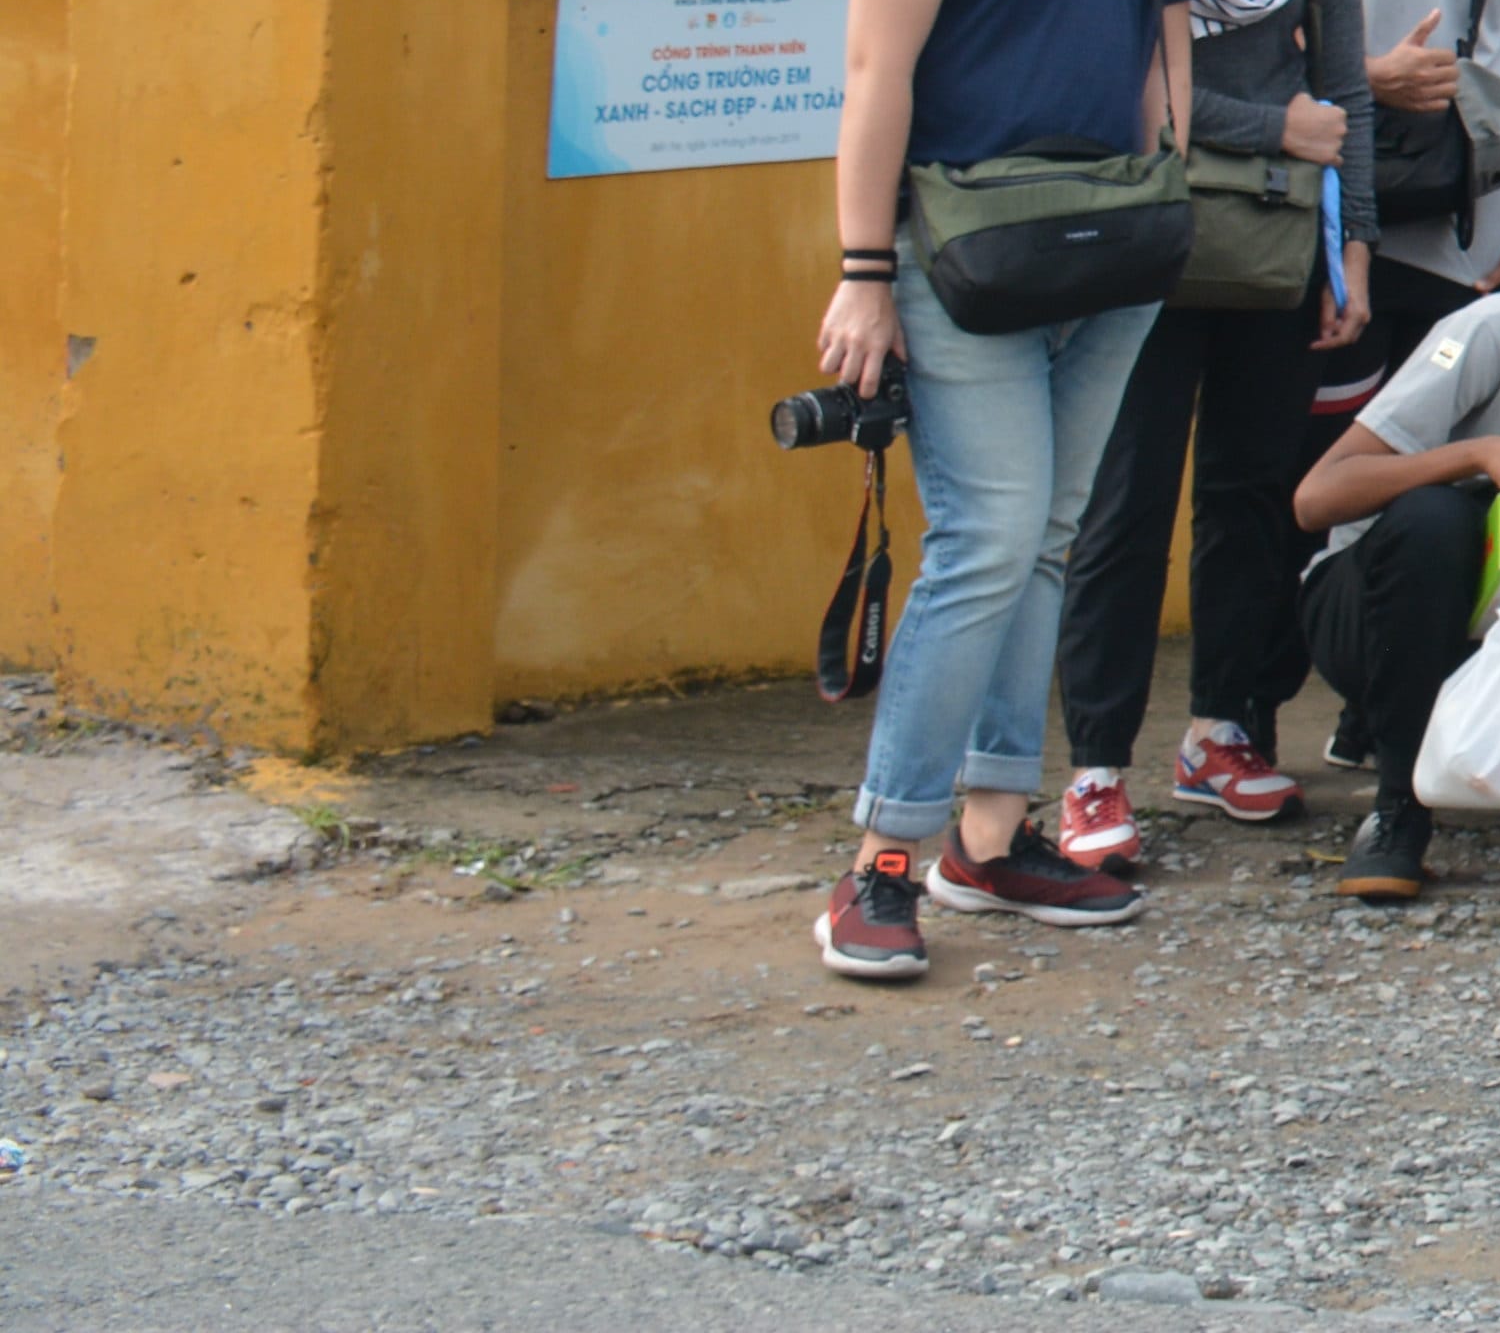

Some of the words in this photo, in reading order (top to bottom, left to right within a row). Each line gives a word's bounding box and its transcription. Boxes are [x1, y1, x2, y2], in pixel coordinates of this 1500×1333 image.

[707, 65, 781, 89] TRƯỜNG
[787, 67, 811, 85] EM
[595, 102, 648, 123] XANH
[771, 93, 797, 113] AN
